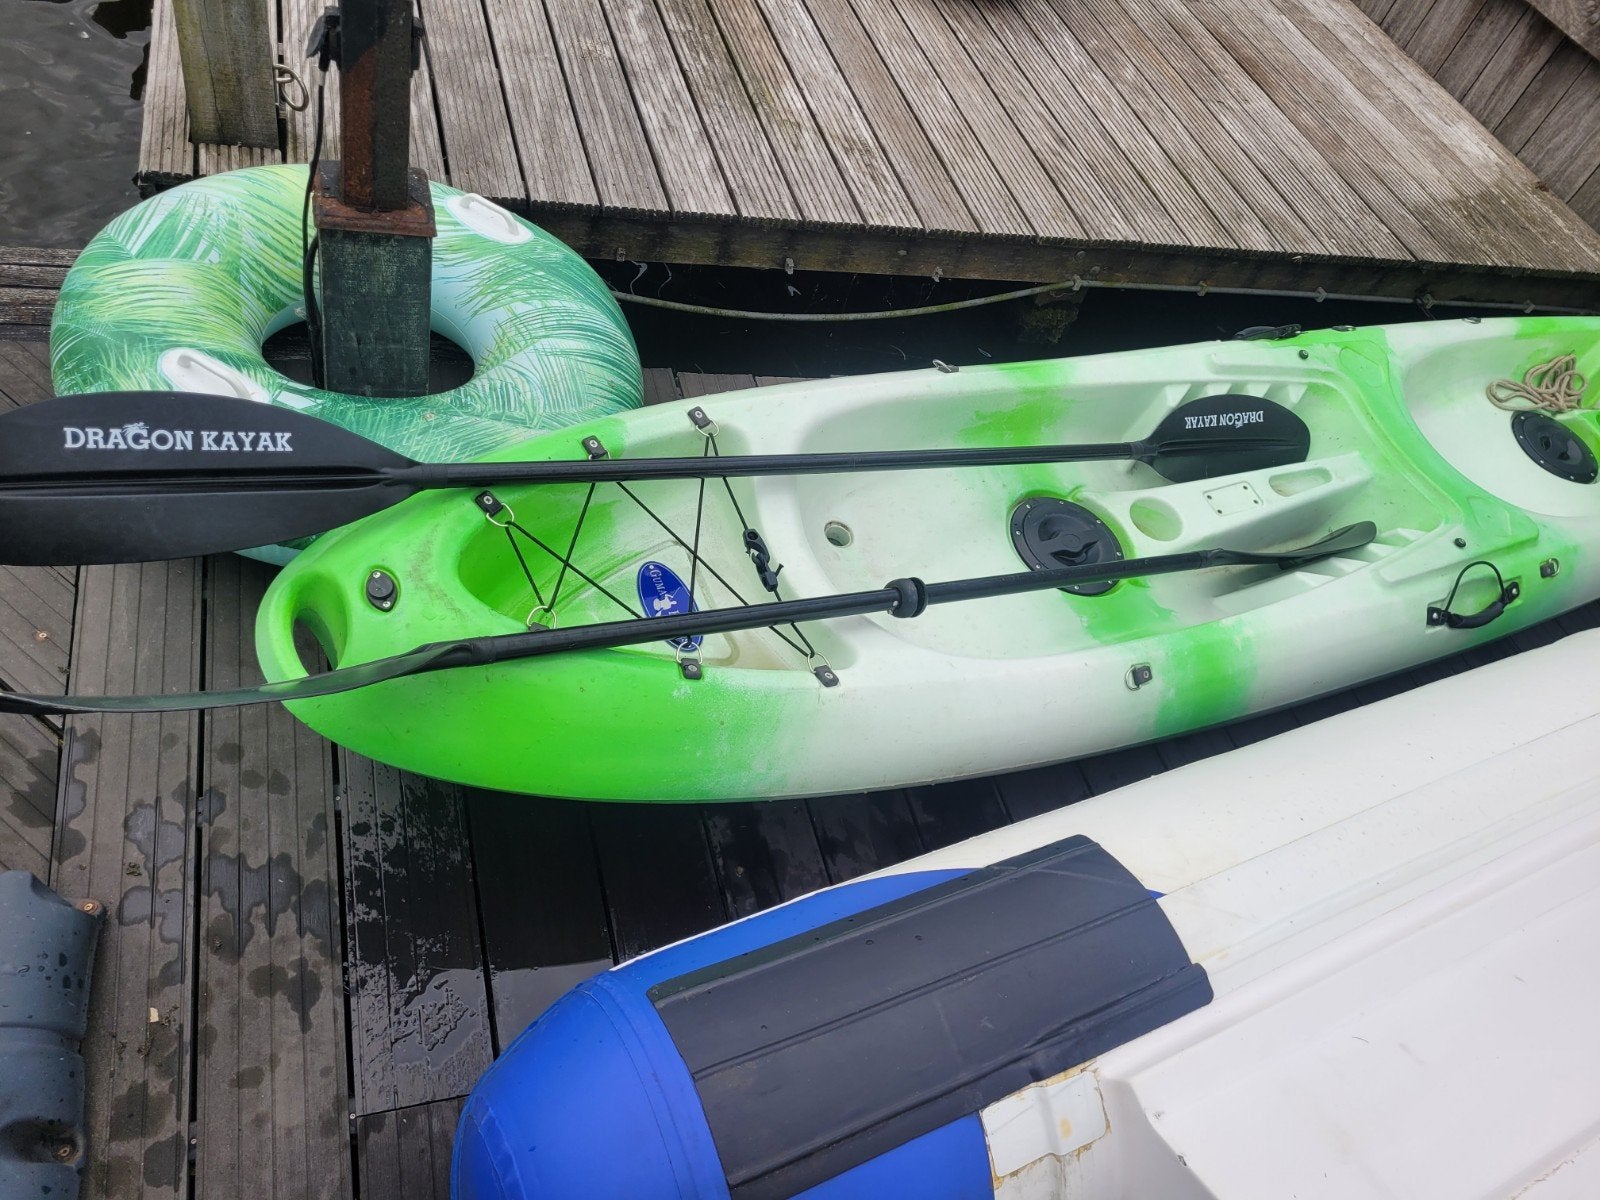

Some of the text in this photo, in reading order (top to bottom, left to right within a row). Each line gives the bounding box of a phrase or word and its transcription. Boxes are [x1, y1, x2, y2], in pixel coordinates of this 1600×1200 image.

[1184, 411, 1264, 429] DRAGON KAYAK
[63, 424, 293, 451] DRAGON KAYAK
